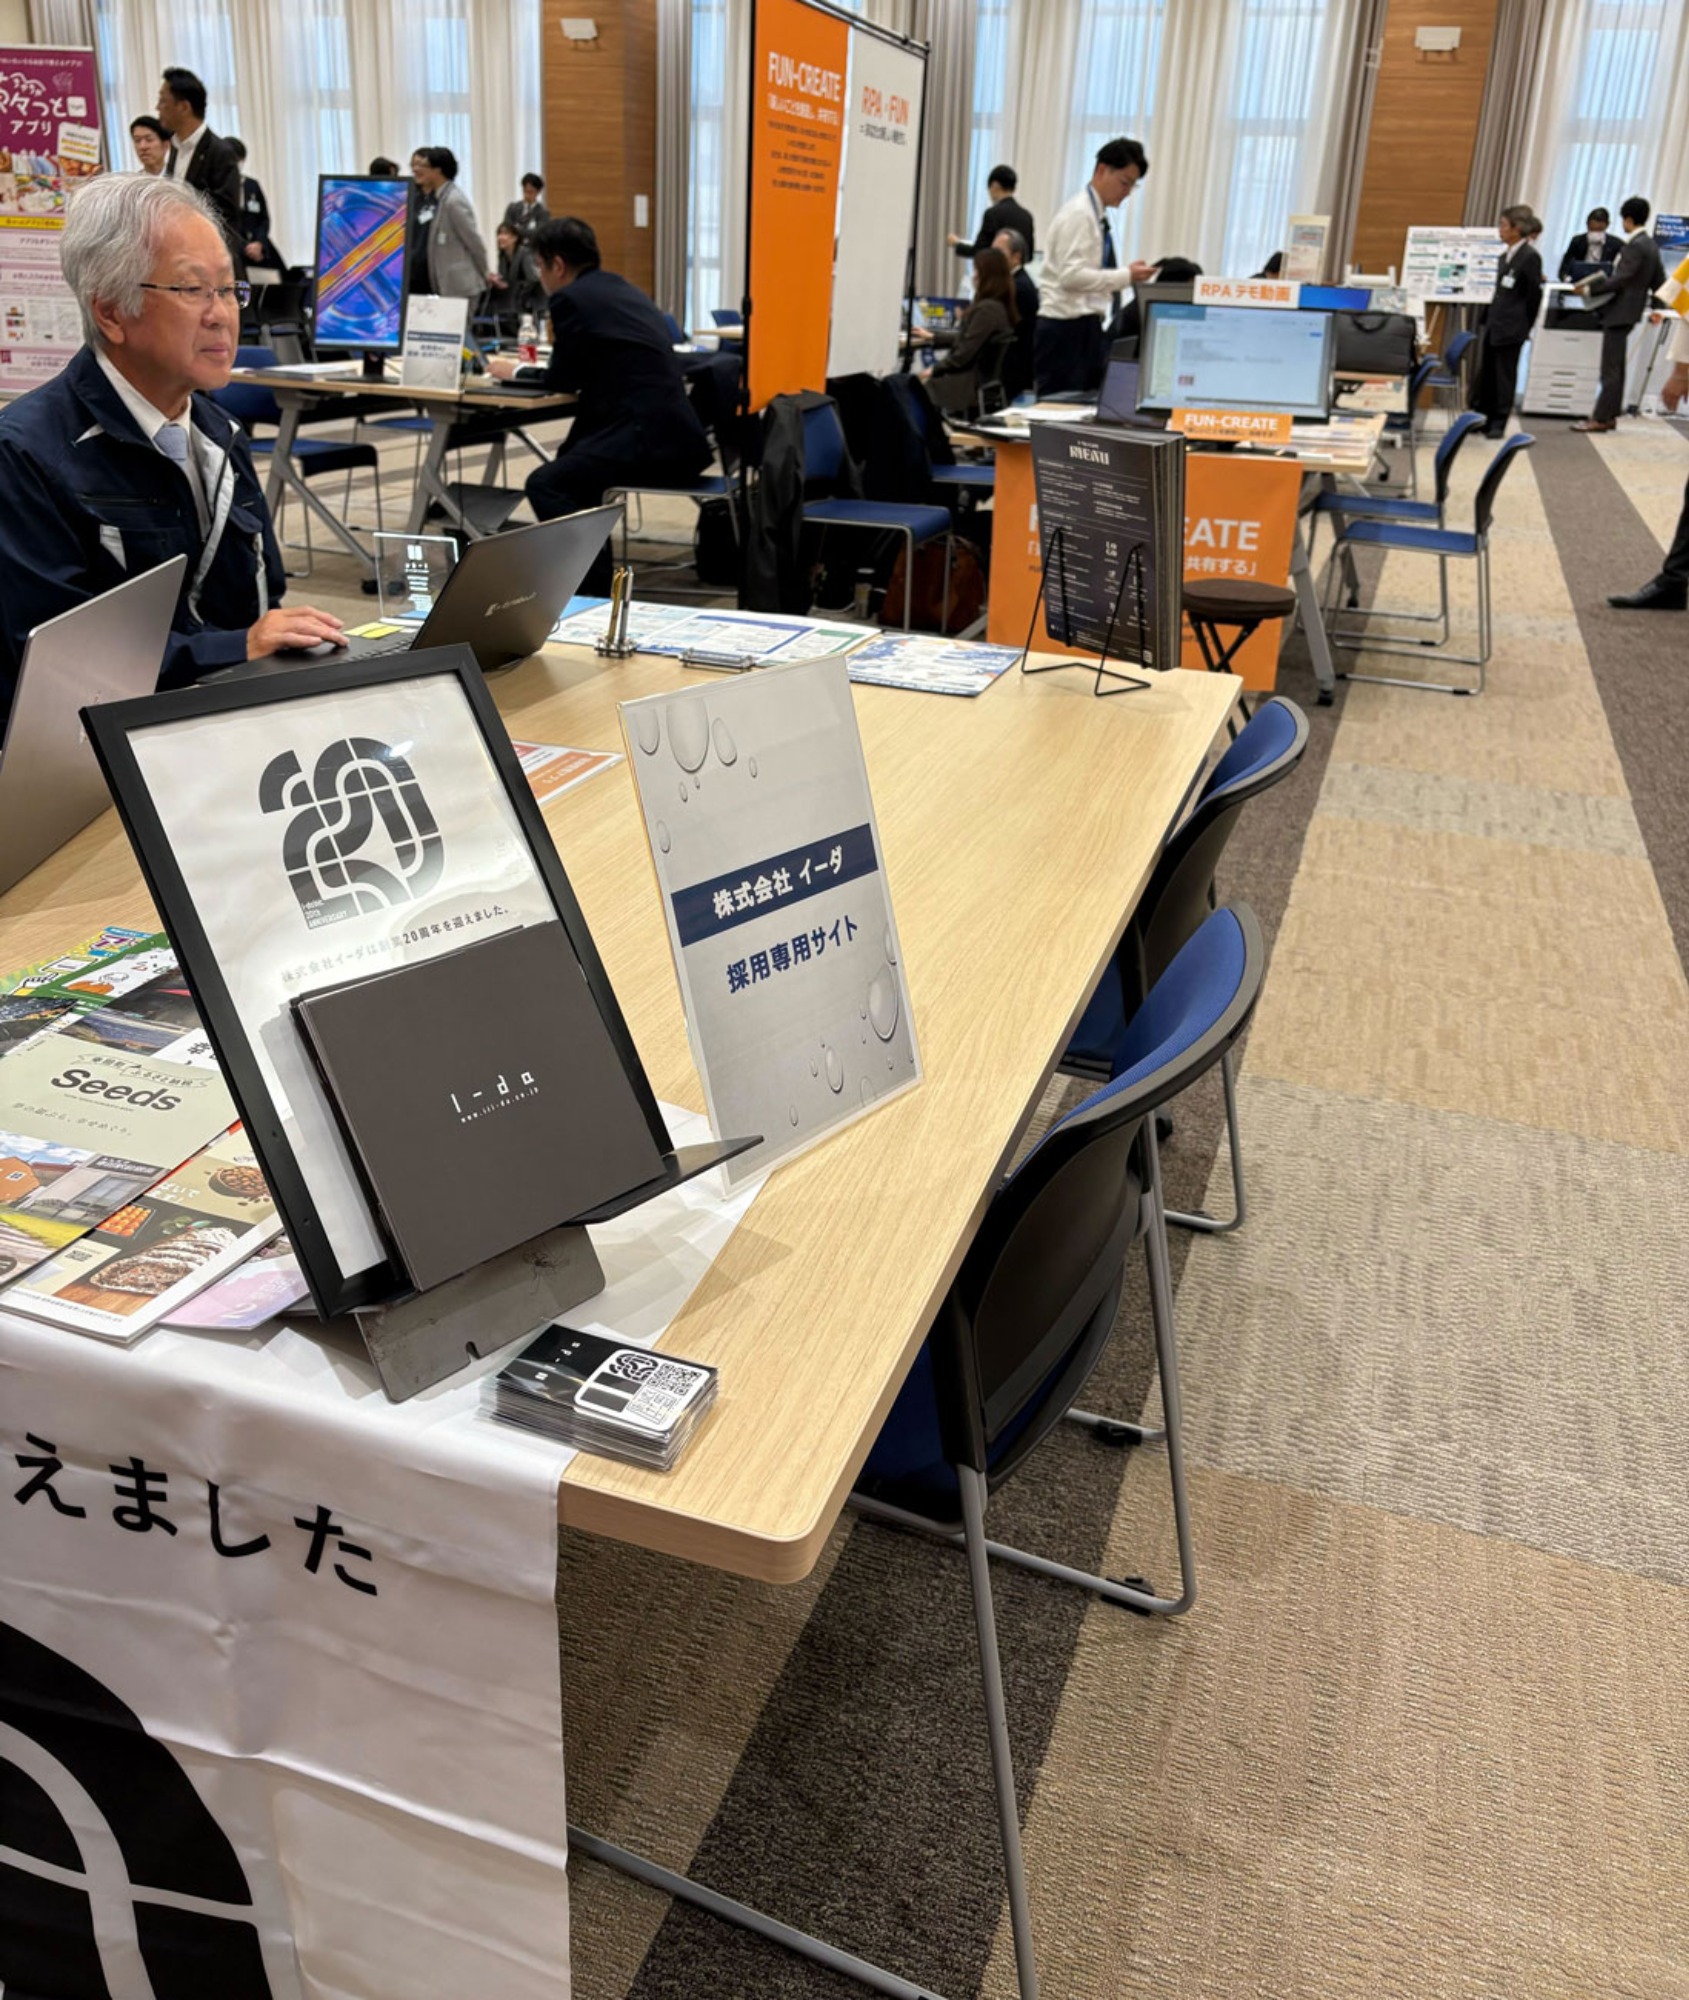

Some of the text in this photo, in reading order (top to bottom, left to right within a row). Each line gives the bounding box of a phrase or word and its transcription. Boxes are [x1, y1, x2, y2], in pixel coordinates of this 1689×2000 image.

[768, 52, 843, 102] FUN-CREATE
[862, 85, 884, 118] RPA
[888, 95, 910, 126] FUN
[10, 120, 52, 136] アプリ
[1201, 283, 1292, 302] RPA デモ動画
[1184, 413, 1279, 430] FUN-CREATE
[712, 845, 844, 920] 株式会社 イーダ
[726, 914, 859, 995] 採用専用サイト
[51, 1068, 183, 1112] Seeds
[14, 1431, 378, 1597] えました
